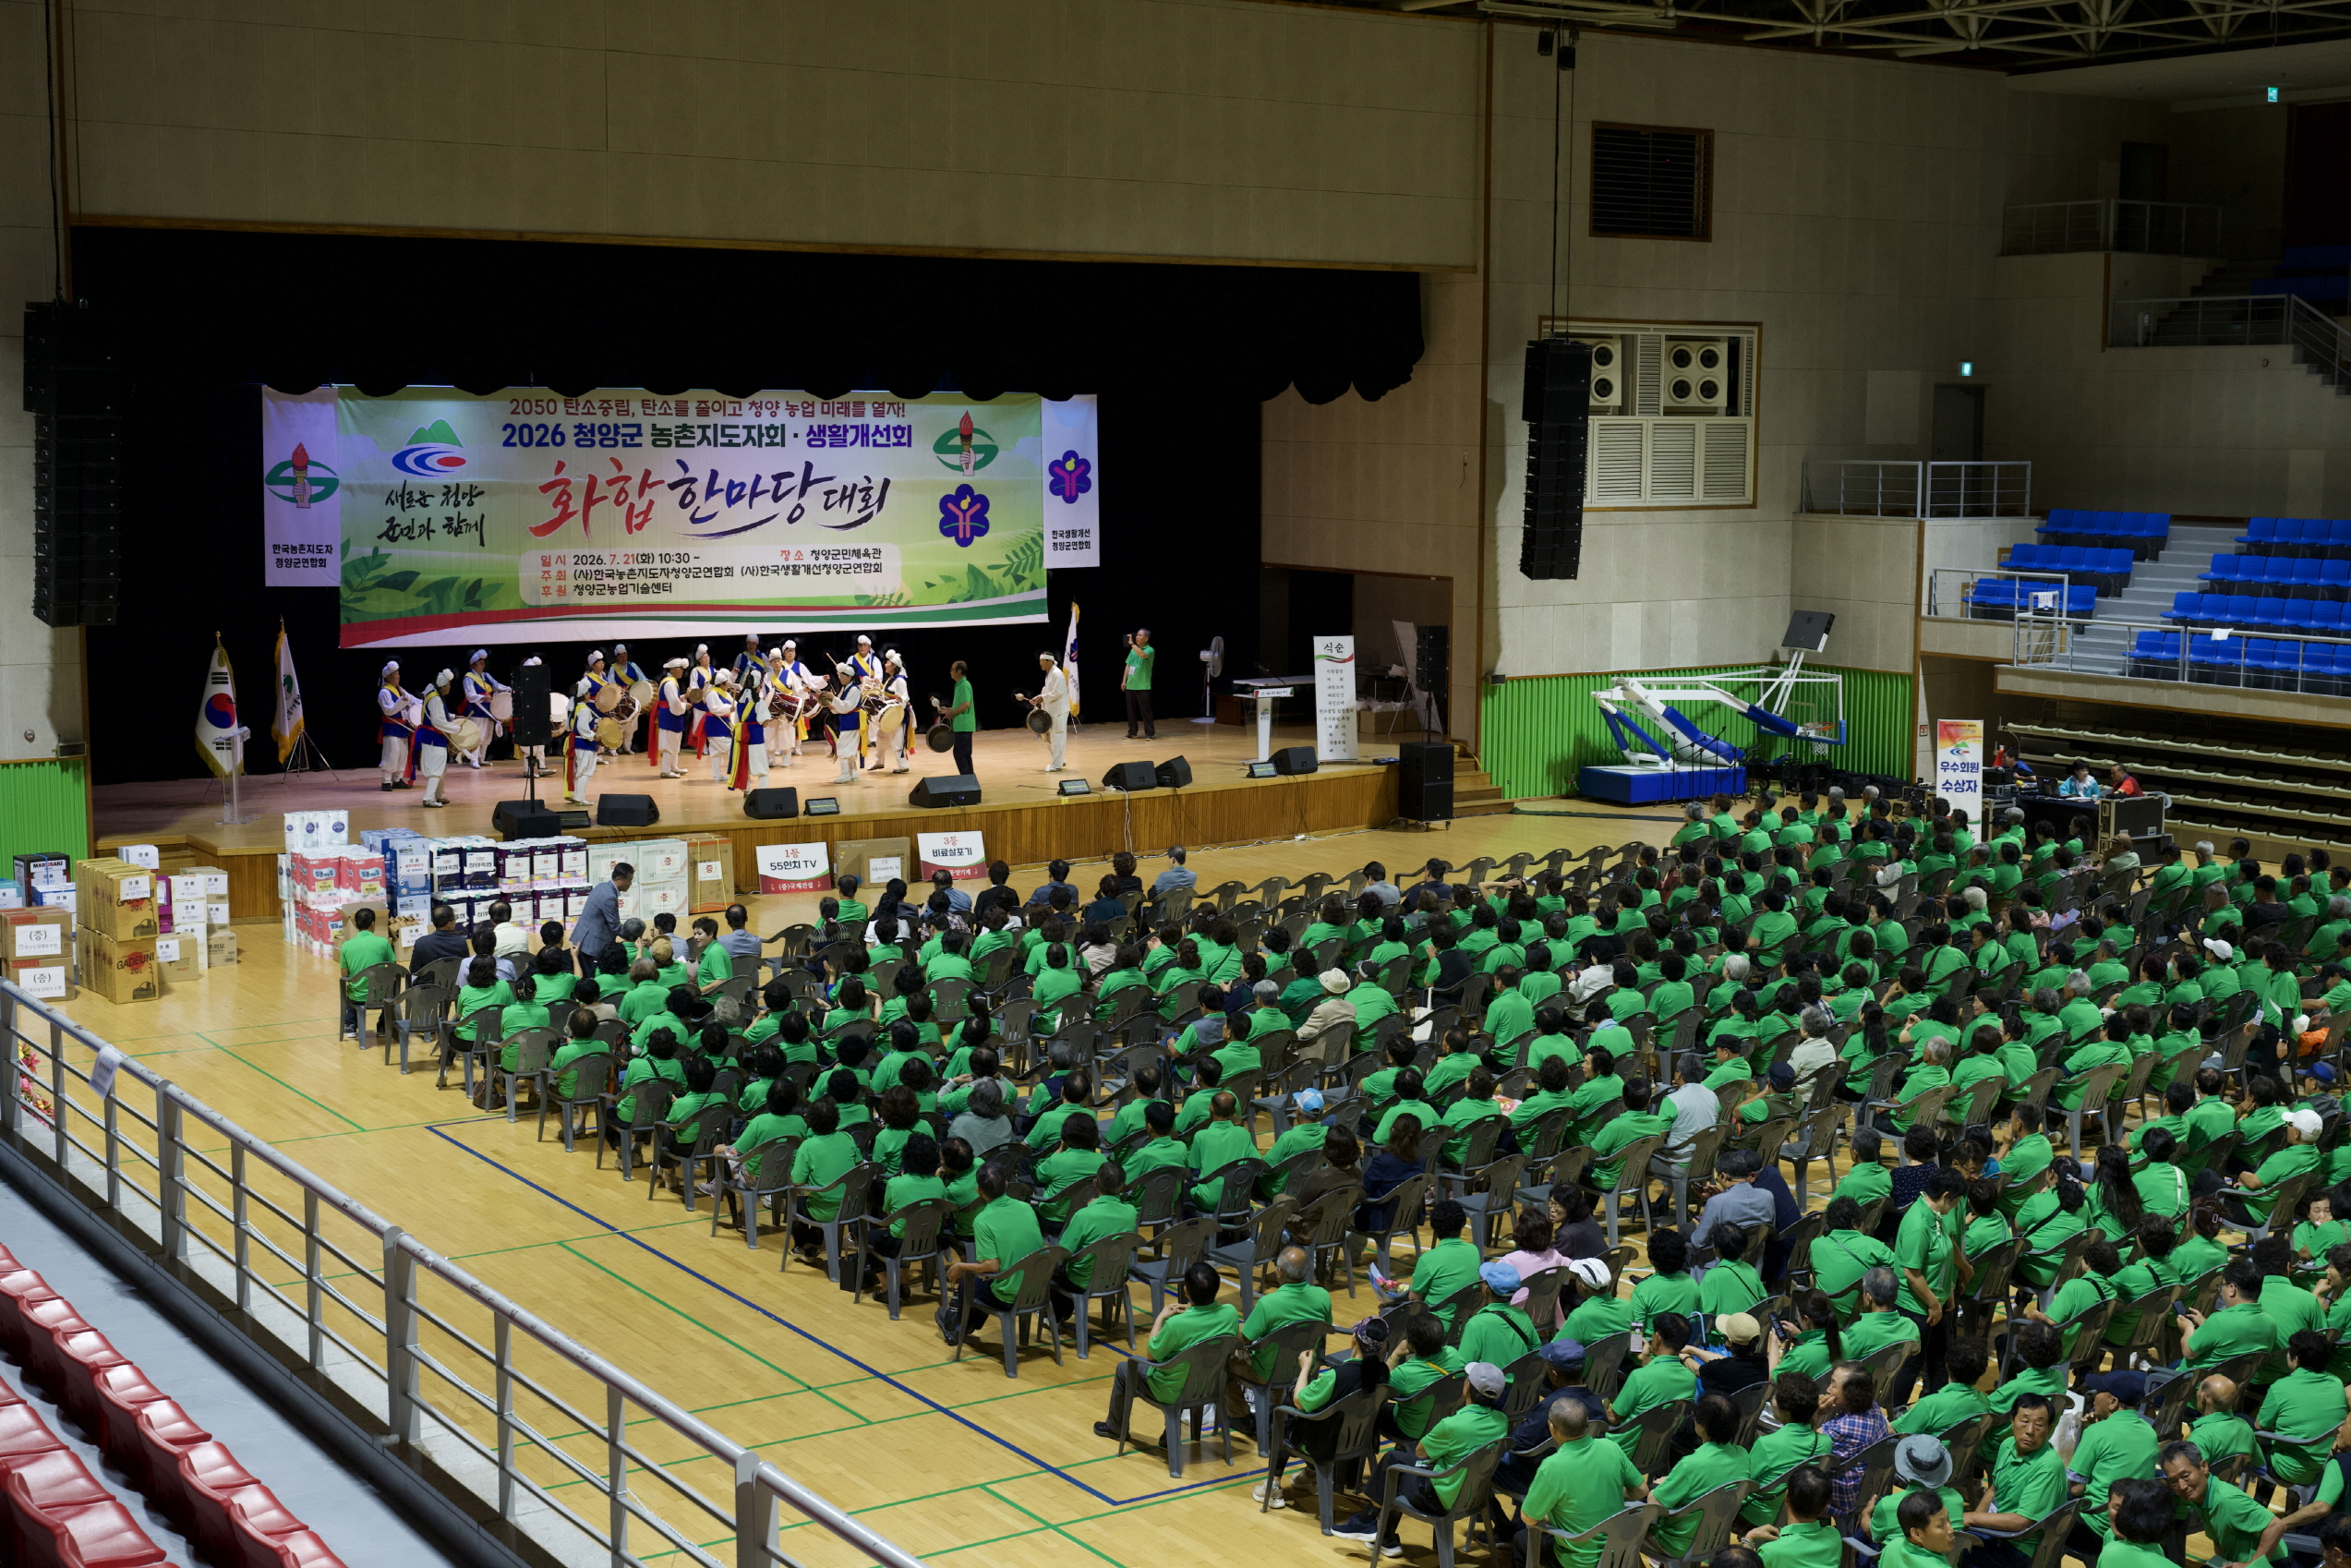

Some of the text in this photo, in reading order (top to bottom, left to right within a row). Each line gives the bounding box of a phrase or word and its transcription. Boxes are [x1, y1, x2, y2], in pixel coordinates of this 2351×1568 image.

[510, 398, 906, 418] 2050 탄소중립, 탄소를 줄이고 청양 농업 미래를 열자!
[502, 423, 566, 448] 2026
[573, 423, 643, 448] 청양군
[651, 423, 786, 448] 농촌지도자회
[806, 424, 912, 448] 생활개선회
[385, 479, 485, 513] 새로운 청양
[527, 456, 891, 542] 화합 한마당 대회
[377, 511, 486, 547] 군민과 함께
[1052, 528, 1091, 539] 한국생활개선
[272, 544, 333, 555] 한국농촌지도자
[1053, 540, 1091, 551] 청양군연합회
[573, 554, 607, 565] 2026.
[658, 552, 690, 564] 10:30
[810, 549, 882, 561] 청양군민체육관
[275, 558, 327, 569] 청양군연합회
[573, 566, 734, 581] (사)한국농촌지도자청양군연합회
[741, 561, 883, 576] (사)한국생활개선청양군연합회
[573, 582, 672, 597] 청양군농업기술센터
[1323, 642, 1344, 654] 식순
[1940, 761, 1979, 773] 우수회원
[1941, 779, 1978, 793] 수상자
[944, 836, 958, 846] 3등
[785, 849, 801, 859] 1등
[932, 847, 972, 857] 비료살포기
[437, 863, 459, 872] 청양축협
[770, 860, 817, 871] 55인치 TV
[30, 930, 47, 941] (증)
[116, 952, 154, 971] GADEUNI
[33, 972, 52, 983] (증)
